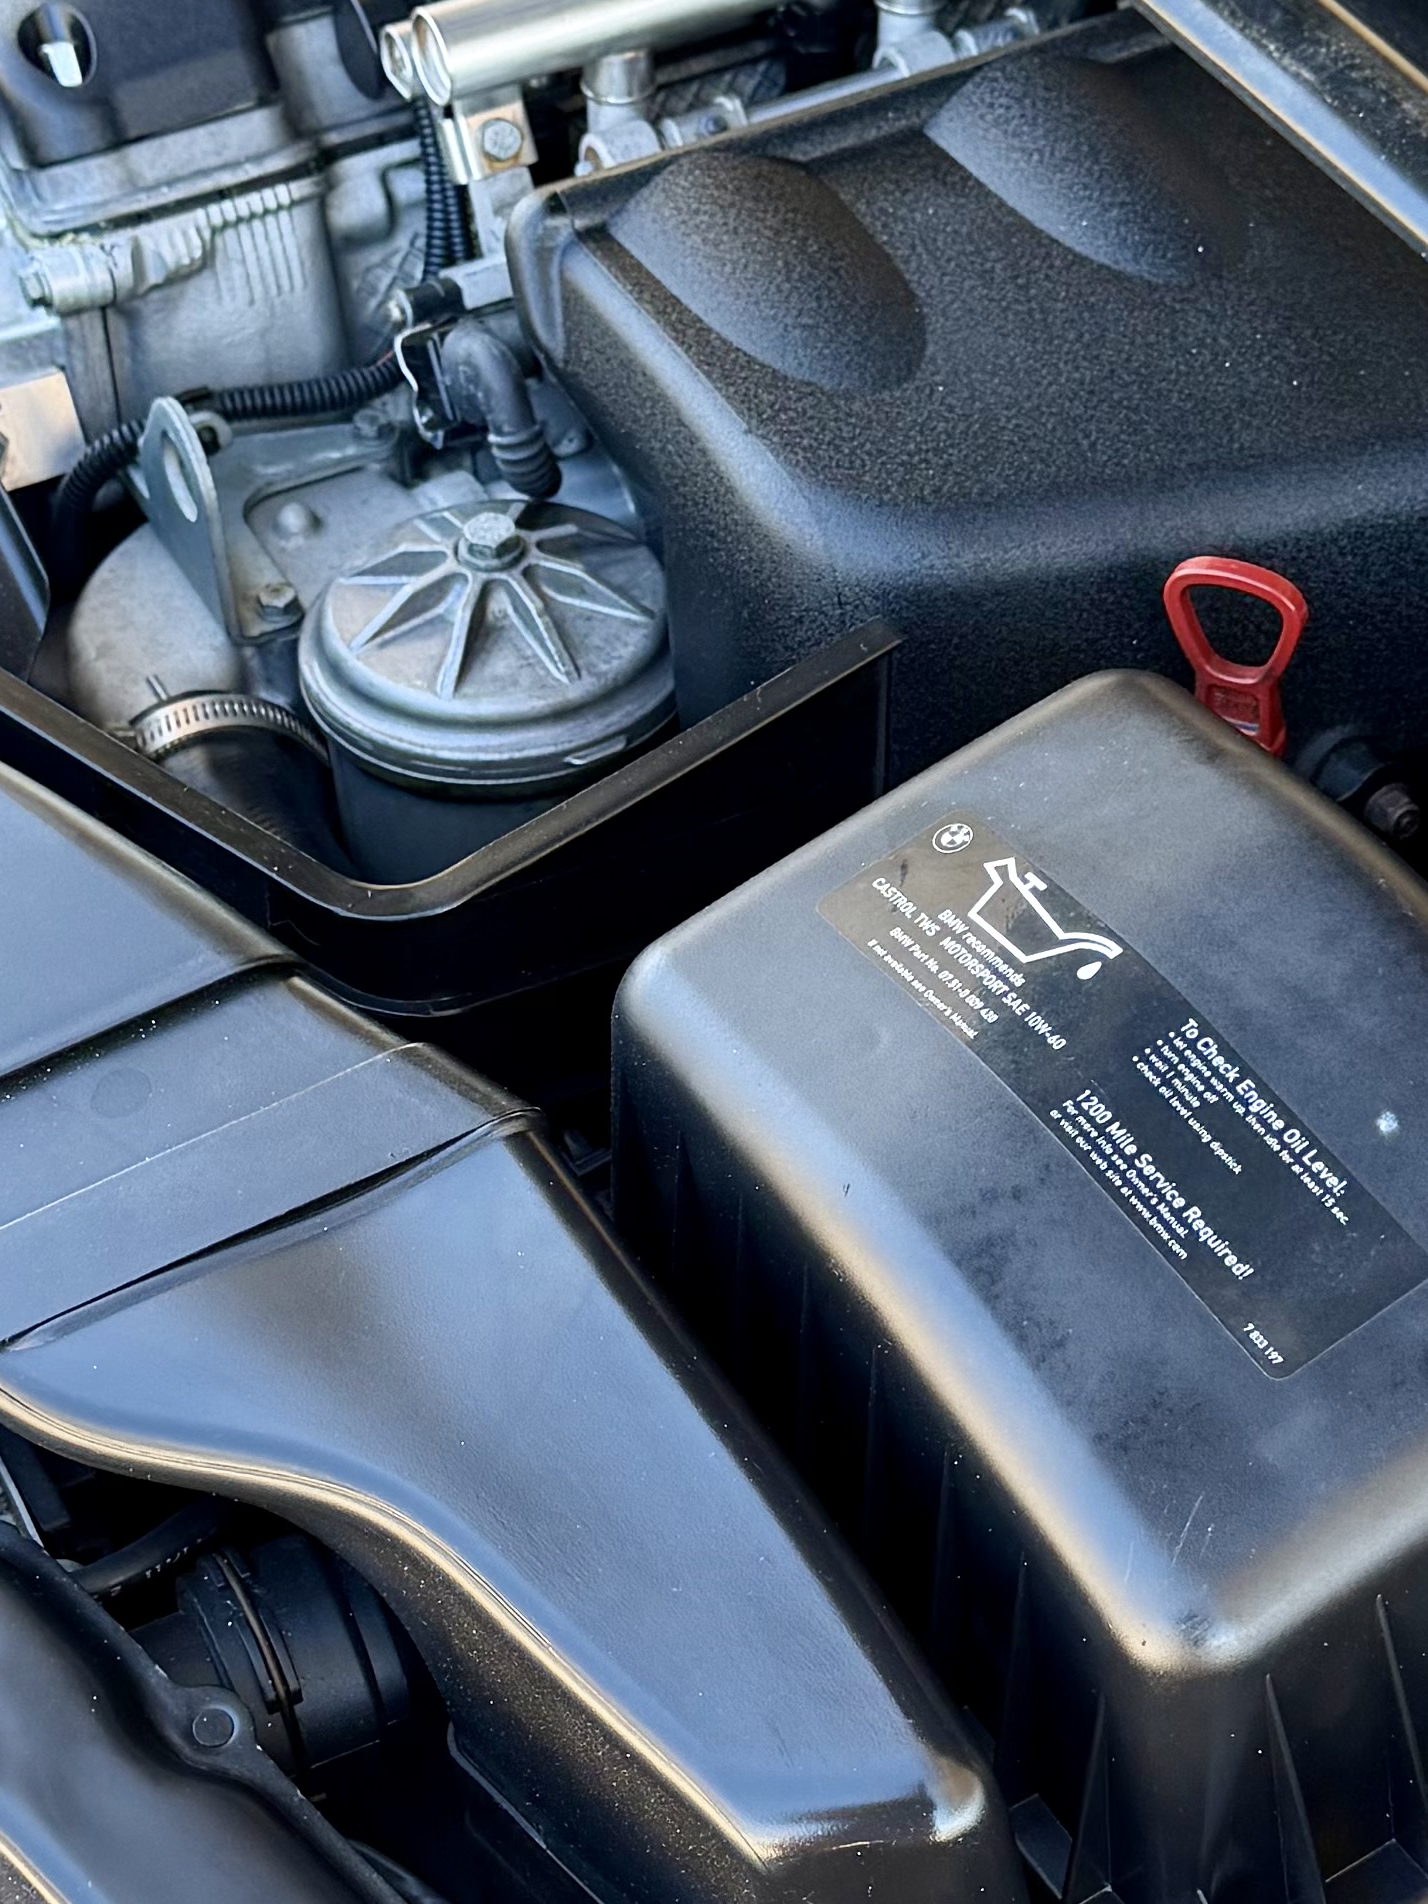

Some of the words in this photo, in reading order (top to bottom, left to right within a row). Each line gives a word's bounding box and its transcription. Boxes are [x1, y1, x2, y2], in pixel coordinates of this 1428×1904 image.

[872, 877, 917, 919] CASTROL
[914, 912, 941, 936] TWS
[939, 936, 1010, 995] MOTORSPORT
[1001, 992, 1030, 1016] SAE
[1024, 1011, 1066, 1050] 10W-60
[889, 927, 914, 947] BMW
[908, 943, 929, 962] Part
[938, 909, 969, 934] BMW
[962, 932, 1026, 987] recommends
[1136, 1062, 1161, 1087] check
[1159, 1086, 1173, 1098] oil
[1169, 1096, 1192, 1119] level
[1188, 1118, 1212, 1143] using
[1210, 1141, 1242, 1175] dipstick
[1149, 1054, 1169, 1073] wait
[1171, 1078, 1200, 1108] minute
[1160, 1045, 1179, 1064] turn
[1177, 1063, 1205, 1092] engine
[1203, 1091, 1219, 1104] off
[1173, 1037, 1187, 1050] let
[1184, 1049, 1212, 1077] engine
[1210, 1077, 1234, 1102] warm
[1245, 1114, 1265, 1135] then
[1263, 1134, 1281, 1151] idle
[1279, 1150, 1294, 1163] for
[1291, 1164, 1304, 1174] at
[1300, 1172, 1324, 1196] least
[1321, 1194, 1336, 1207] 15
[1181, 1018, 1199, 1039] To
[1197, 1037, 1240, 1083] Check
[1236, 1079, 1285, 1130] Engine
[1283, 1129, 1309, 1154] Oil
[1302, 1149, 1347, 1197] Level:
[1050, 1110, 1062, 1119] or
[1060, 1119, 1079, 1138] visit
[1075, 1136, 1092, 1151] our
[1089, 1151, 1108, 1170] web
[1105, 1170, 1122, 1186] site
[1120, 1187, 1133, 1197] at
[1129, 1195, 1187, 1260] www.bmw.com
[1062, 1100, 1079, 1115] For
[1075, 1116, 1098, 1138] more
[1096, 1136, 1113, 1155] info
[1111, 1154, 1128, 1170] see
[1126, 1169, 1159, 1205] Owner's
[1076, 1089, 1112, 1124] 1200
[1105, 1121, 1137, 1155] Mile
[1134, 1153, 1186, 1209] Service
[1182, 1206, 1254, 1280] Required!
[1264, 1347, 1284, 1364] 197
